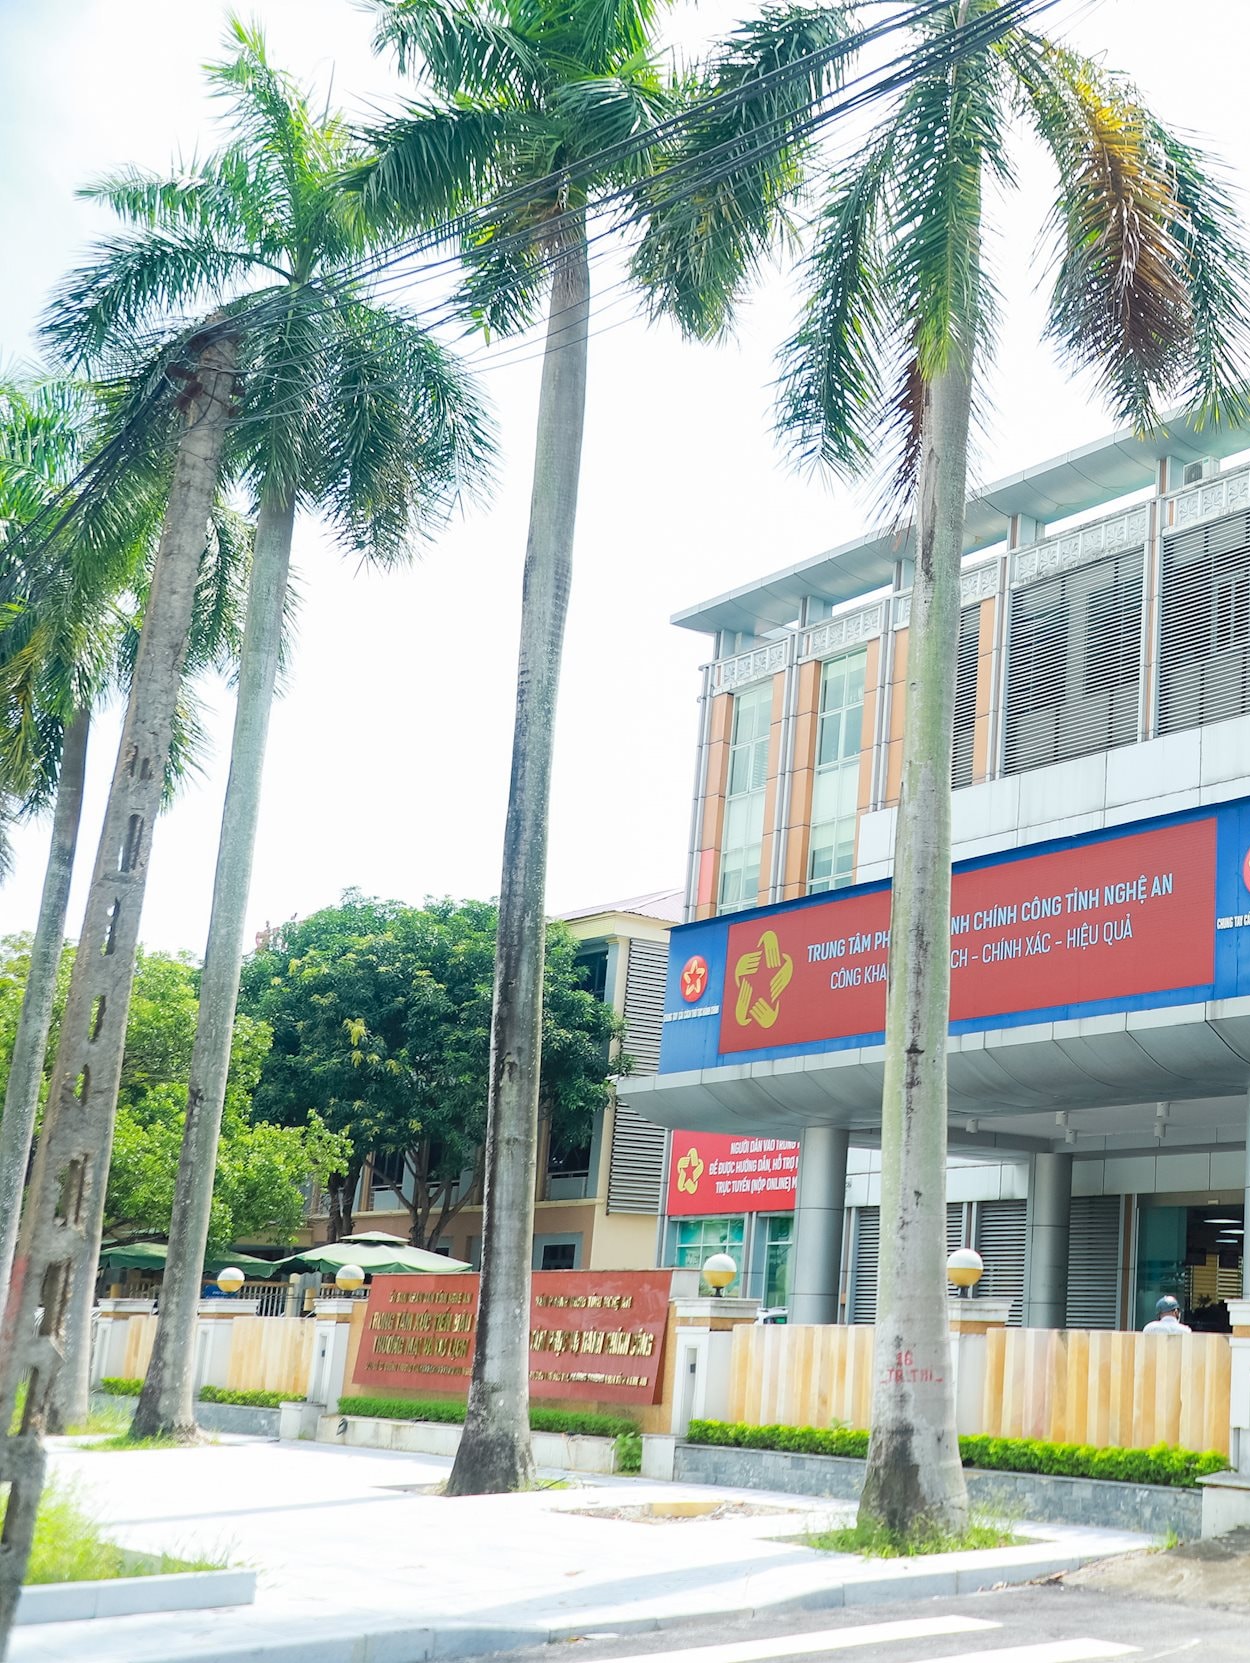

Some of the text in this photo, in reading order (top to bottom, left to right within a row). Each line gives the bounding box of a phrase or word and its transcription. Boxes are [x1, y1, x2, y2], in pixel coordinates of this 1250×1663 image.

[808, 872, 1174, 963] TRUNG TÂM PH NH CHÍNH CÔNG TỈNH NGHỆ AN
[830, 967, 862, 991] CÔNG
[864, 962, 887, 985] KHA
[950, 948, 968, 970] CH
[982, 932, 1022, 964] CHÍNH
[1025, 930, 1051, 956] XÁC
[1066, 923, 1099, 950] HIỆU
[1103, 913, 1134, 946] QUẢ
